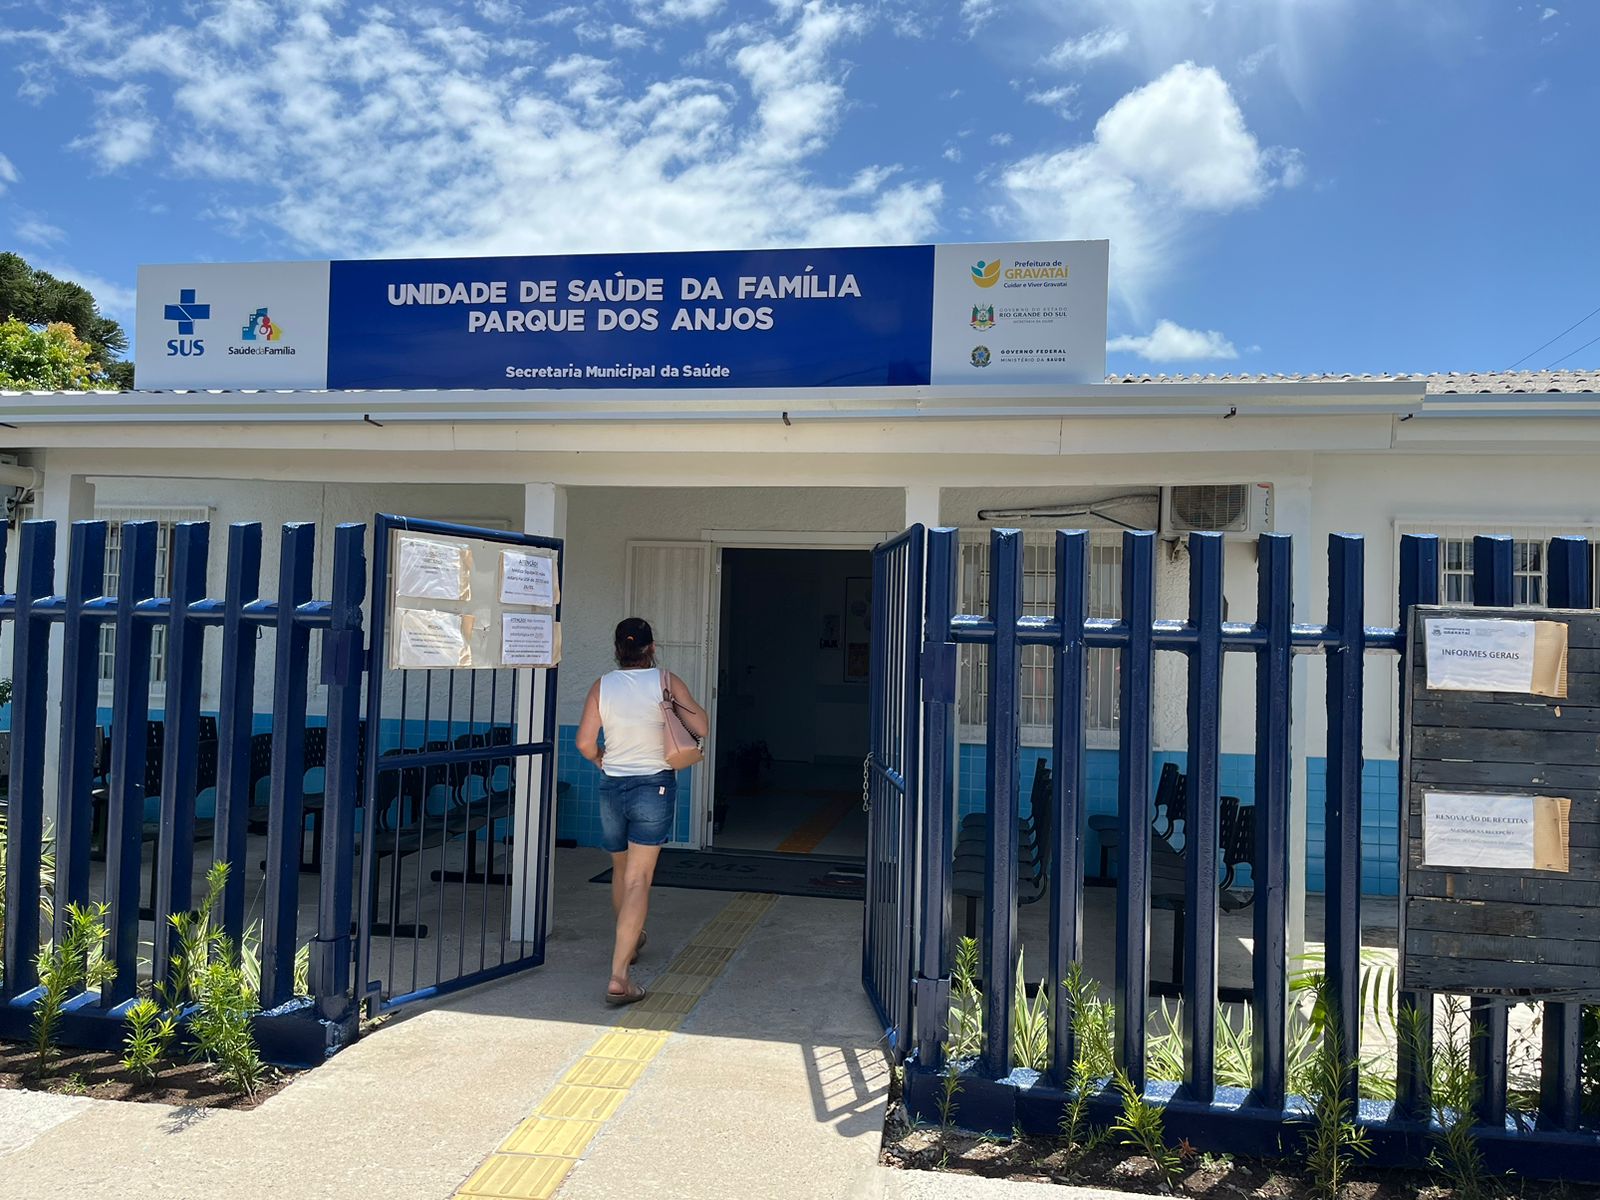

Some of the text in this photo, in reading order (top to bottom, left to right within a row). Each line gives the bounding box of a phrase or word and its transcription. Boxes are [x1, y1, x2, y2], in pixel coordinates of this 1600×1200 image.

[388, 281, 507, 306] UNIDADE
[520, 280, 557, 303] DE
[681, 276, 724, 300] DA
[738, 265, 862, 300] FAMÍLIA
[468, 307, 774, 333] PARQUE DOS ANJOS
[167, 339, 205, 357] SUS
[505, 363, 730, 380] Secretaria Municipal da Saúde
[1441, 648, 1520, 660] INFORMES GERAIS
[1435, 814, 1480, 822] RENOVAÇÃO
